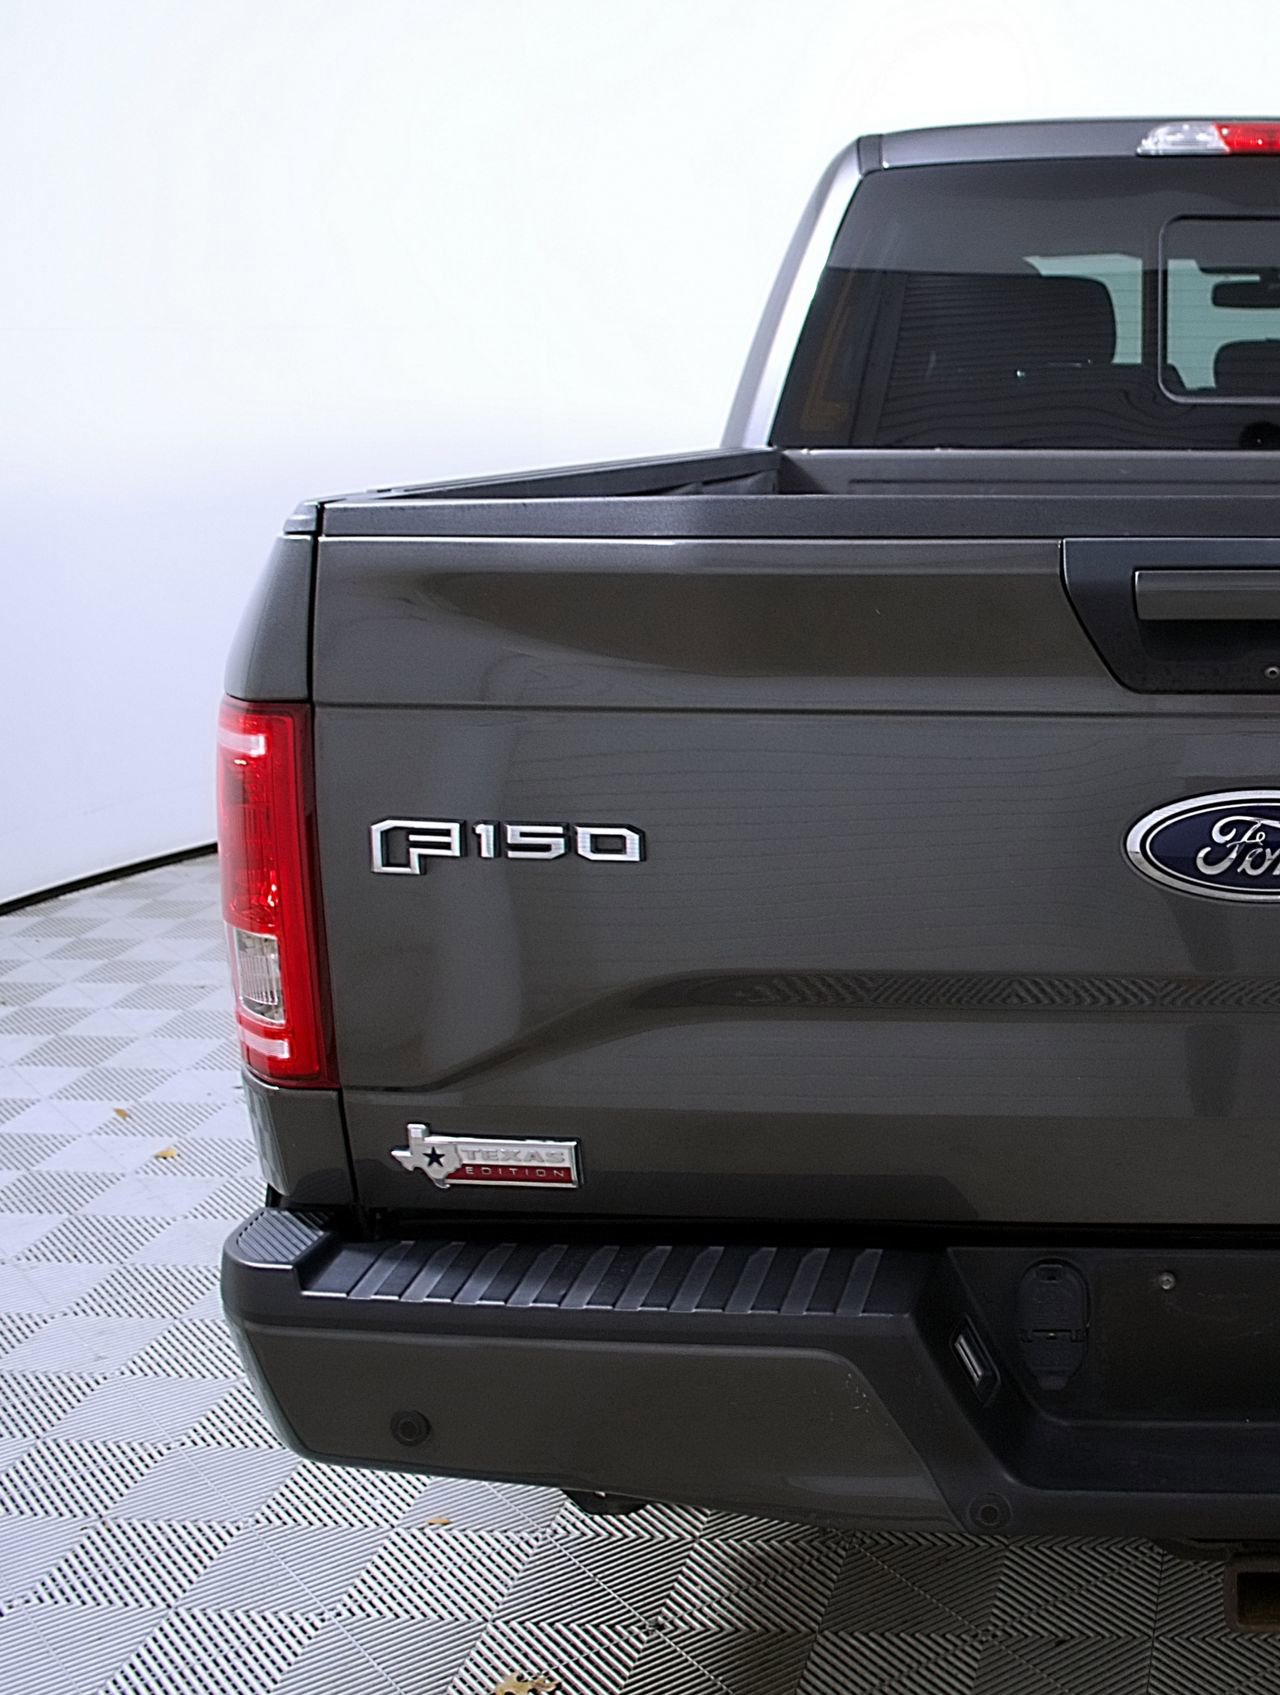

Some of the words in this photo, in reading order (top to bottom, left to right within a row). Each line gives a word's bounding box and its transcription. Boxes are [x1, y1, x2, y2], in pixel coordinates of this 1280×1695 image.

[370, 816, 647, 876] F150
[461, 1148, 566, 1163] TEXAS
[465, 1166, 565, 1177] EDITION
